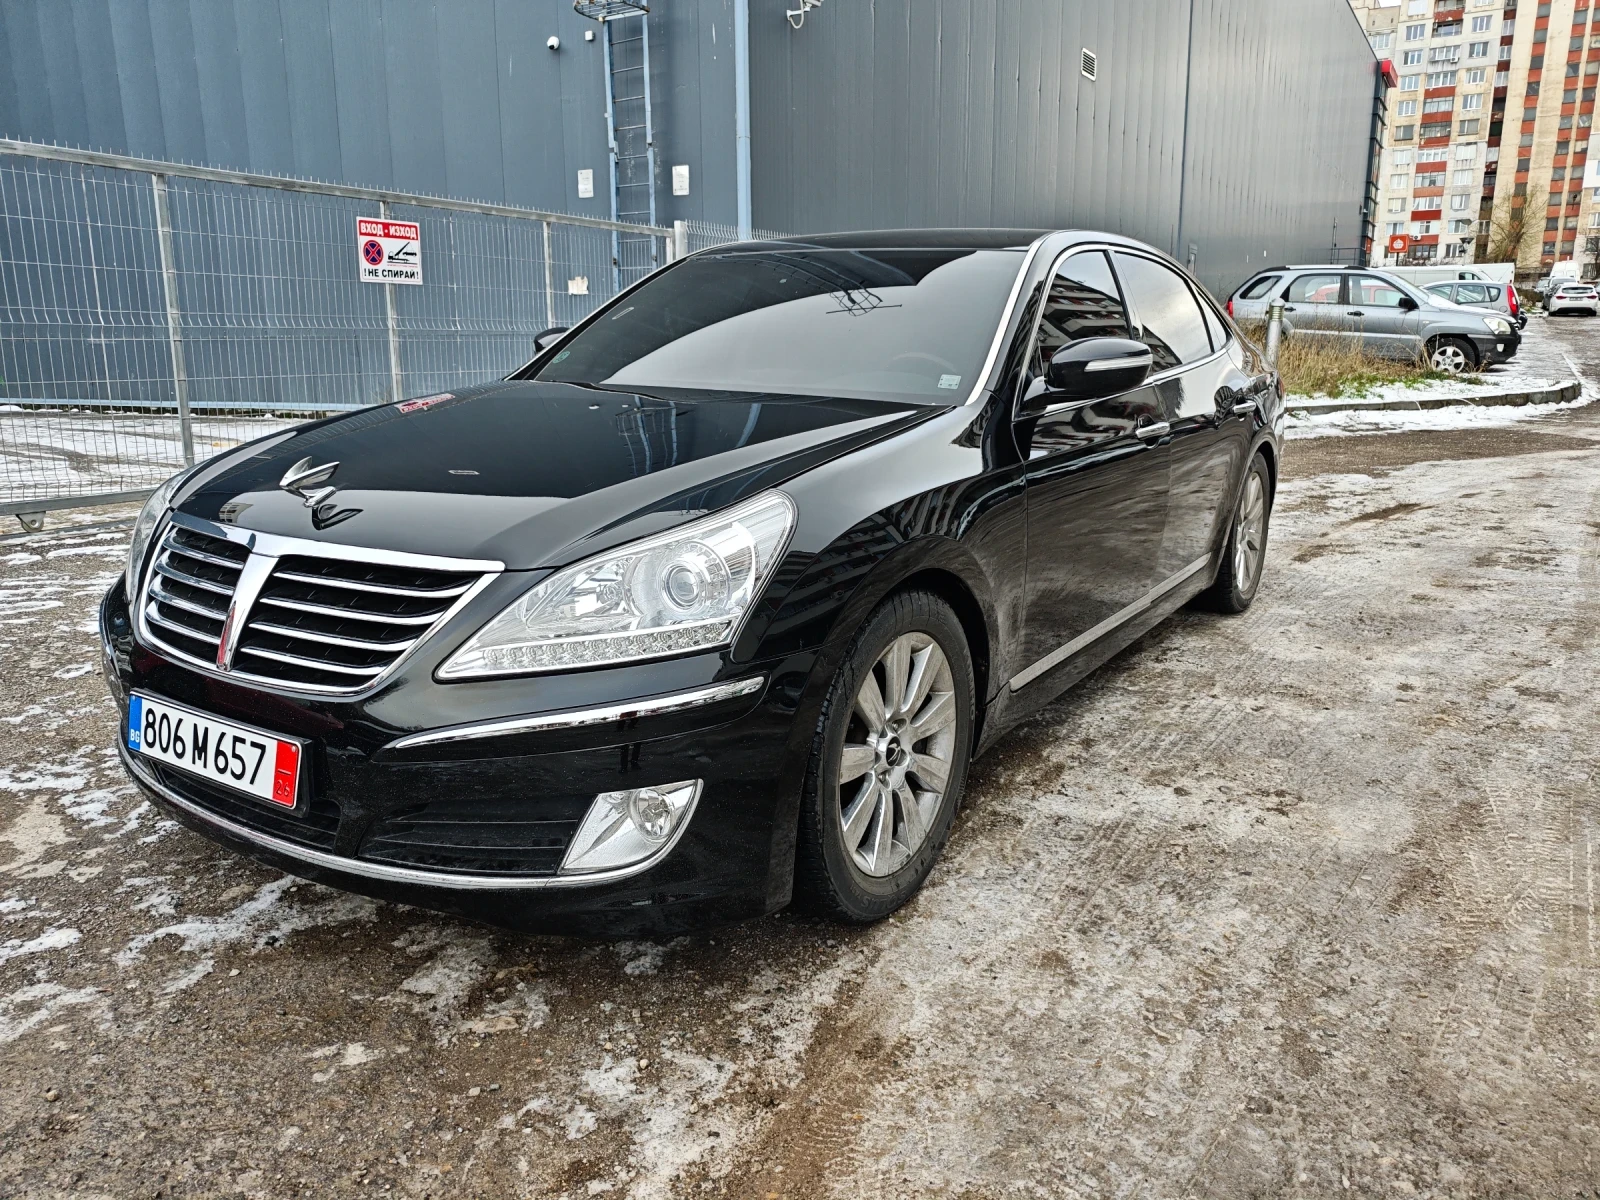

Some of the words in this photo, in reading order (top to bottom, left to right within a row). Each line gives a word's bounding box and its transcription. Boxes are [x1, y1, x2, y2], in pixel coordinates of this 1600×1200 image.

[360, 222, 384, 236] ВХОД
[389, 225, 417, 239] ИЗХОД
[130, 728, 140, 743] BG
[276, 779, 291, 797] 26
